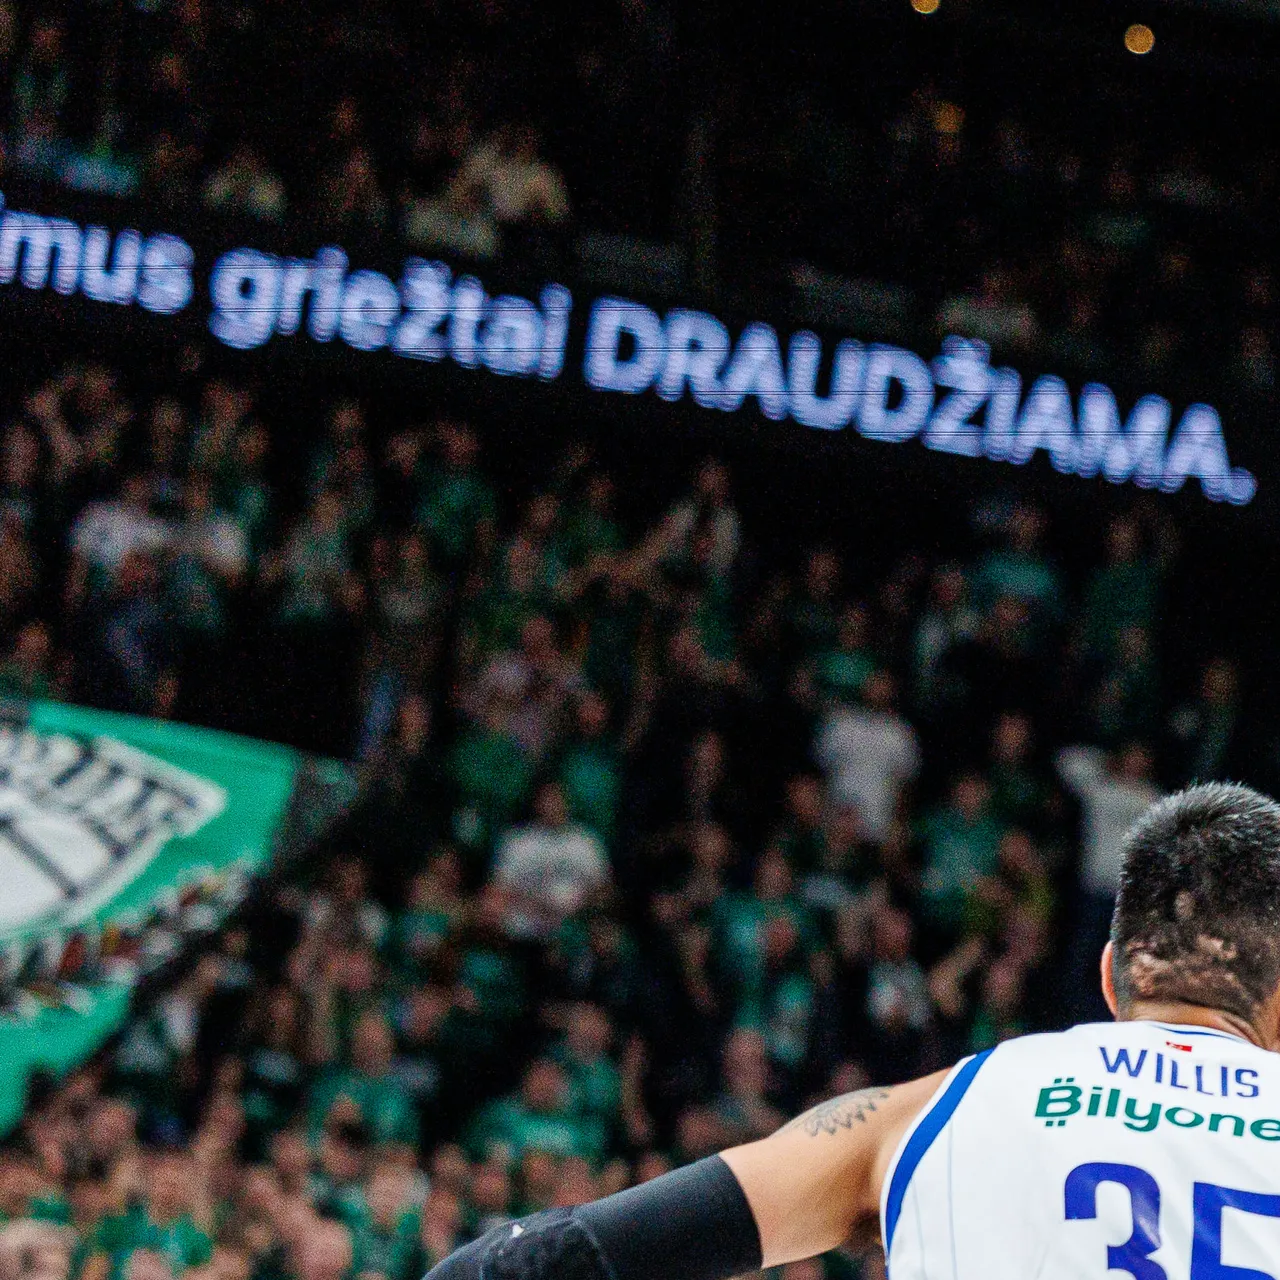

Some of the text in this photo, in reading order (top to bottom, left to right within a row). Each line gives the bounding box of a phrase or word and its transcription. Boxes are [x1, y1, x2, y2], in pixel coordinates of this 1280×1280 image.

[0, 192, 1258, 506] mus griežtai DRAUDŽIAMA.
[1099, 1046, 1260, 1098] WILLIS
